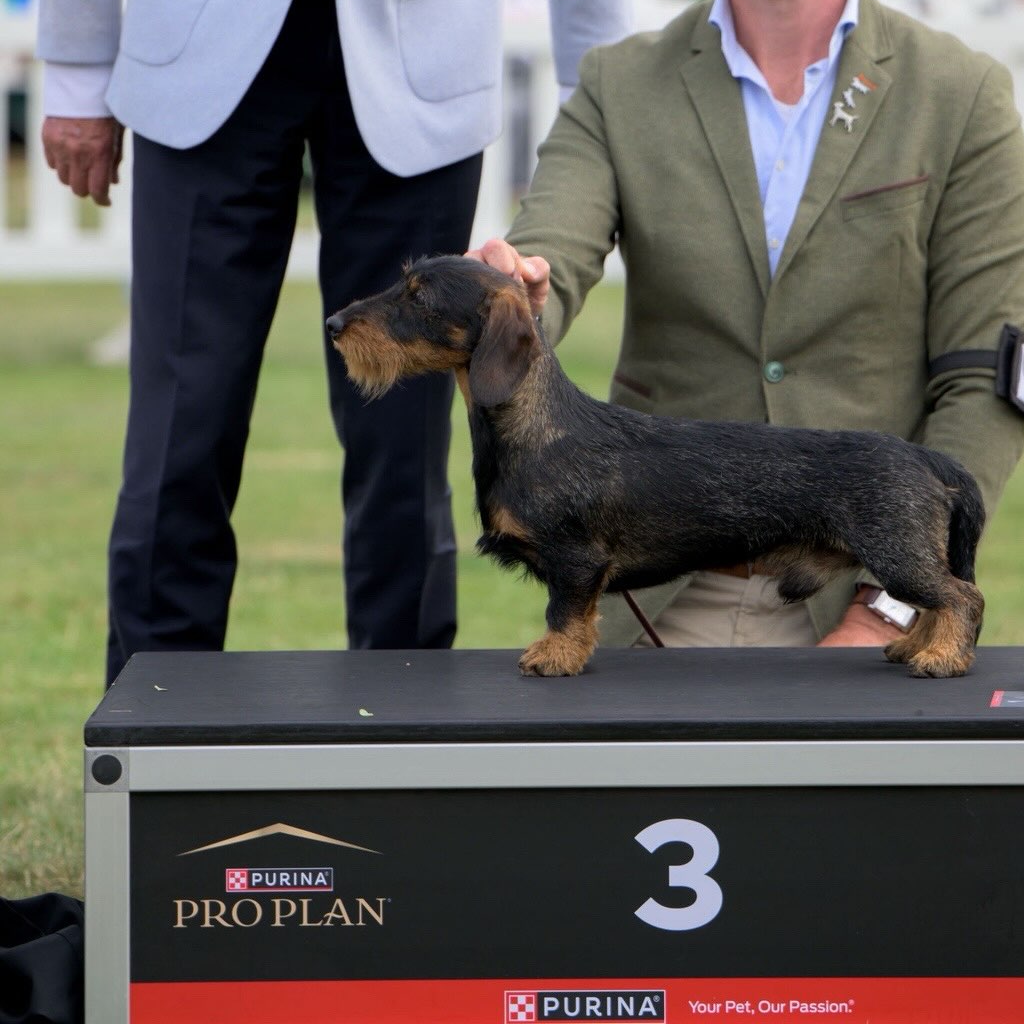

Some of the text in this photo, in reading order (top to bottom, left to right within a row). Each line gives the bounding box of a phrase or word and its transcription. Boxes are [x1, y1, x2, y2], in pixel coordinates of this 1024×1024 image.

[633, 818, 723, 931] 3
[172, 897, 387, 928] PRO PLAN
[688, 1000, 722, 1014] Your
[725, 1000, 756, 1015] Pet,
[758, 1000, 787, 1014] Our
